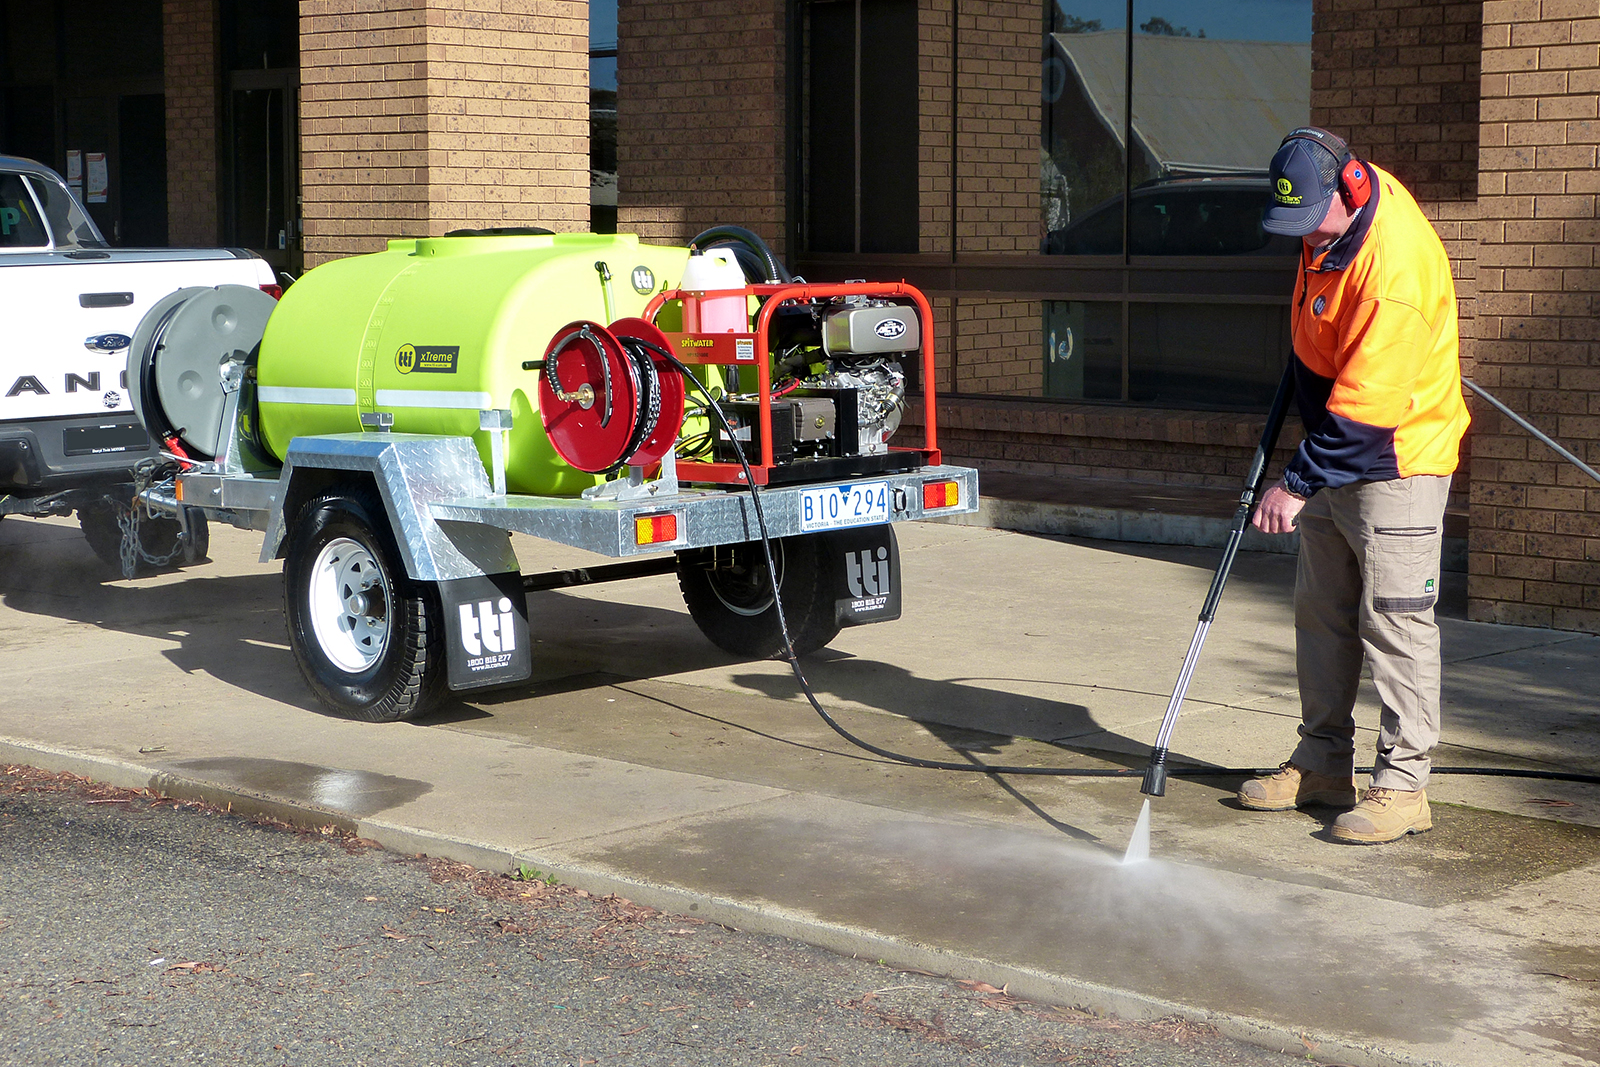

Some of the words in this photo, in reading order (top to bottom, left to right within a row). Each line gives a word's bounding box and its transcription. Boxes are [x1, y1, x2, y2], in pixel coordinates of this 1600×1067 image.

[634, 270, 653, 289] tti
[399, 350, 413, 367] tti
[420, 351, 453, 362] xTreme
[804, 493, 838, 522] B10
[853, 487, 886, 516] 294
[806, 521, 829, 529] VICTORIA
[844, 516, 870, 525] EDUCATION
[845, 546, 890, 598] tti
[459, 597, 516, 656] tti
[467, 657, 484, 667] 1800
[497, 653, 512, 662] 277
